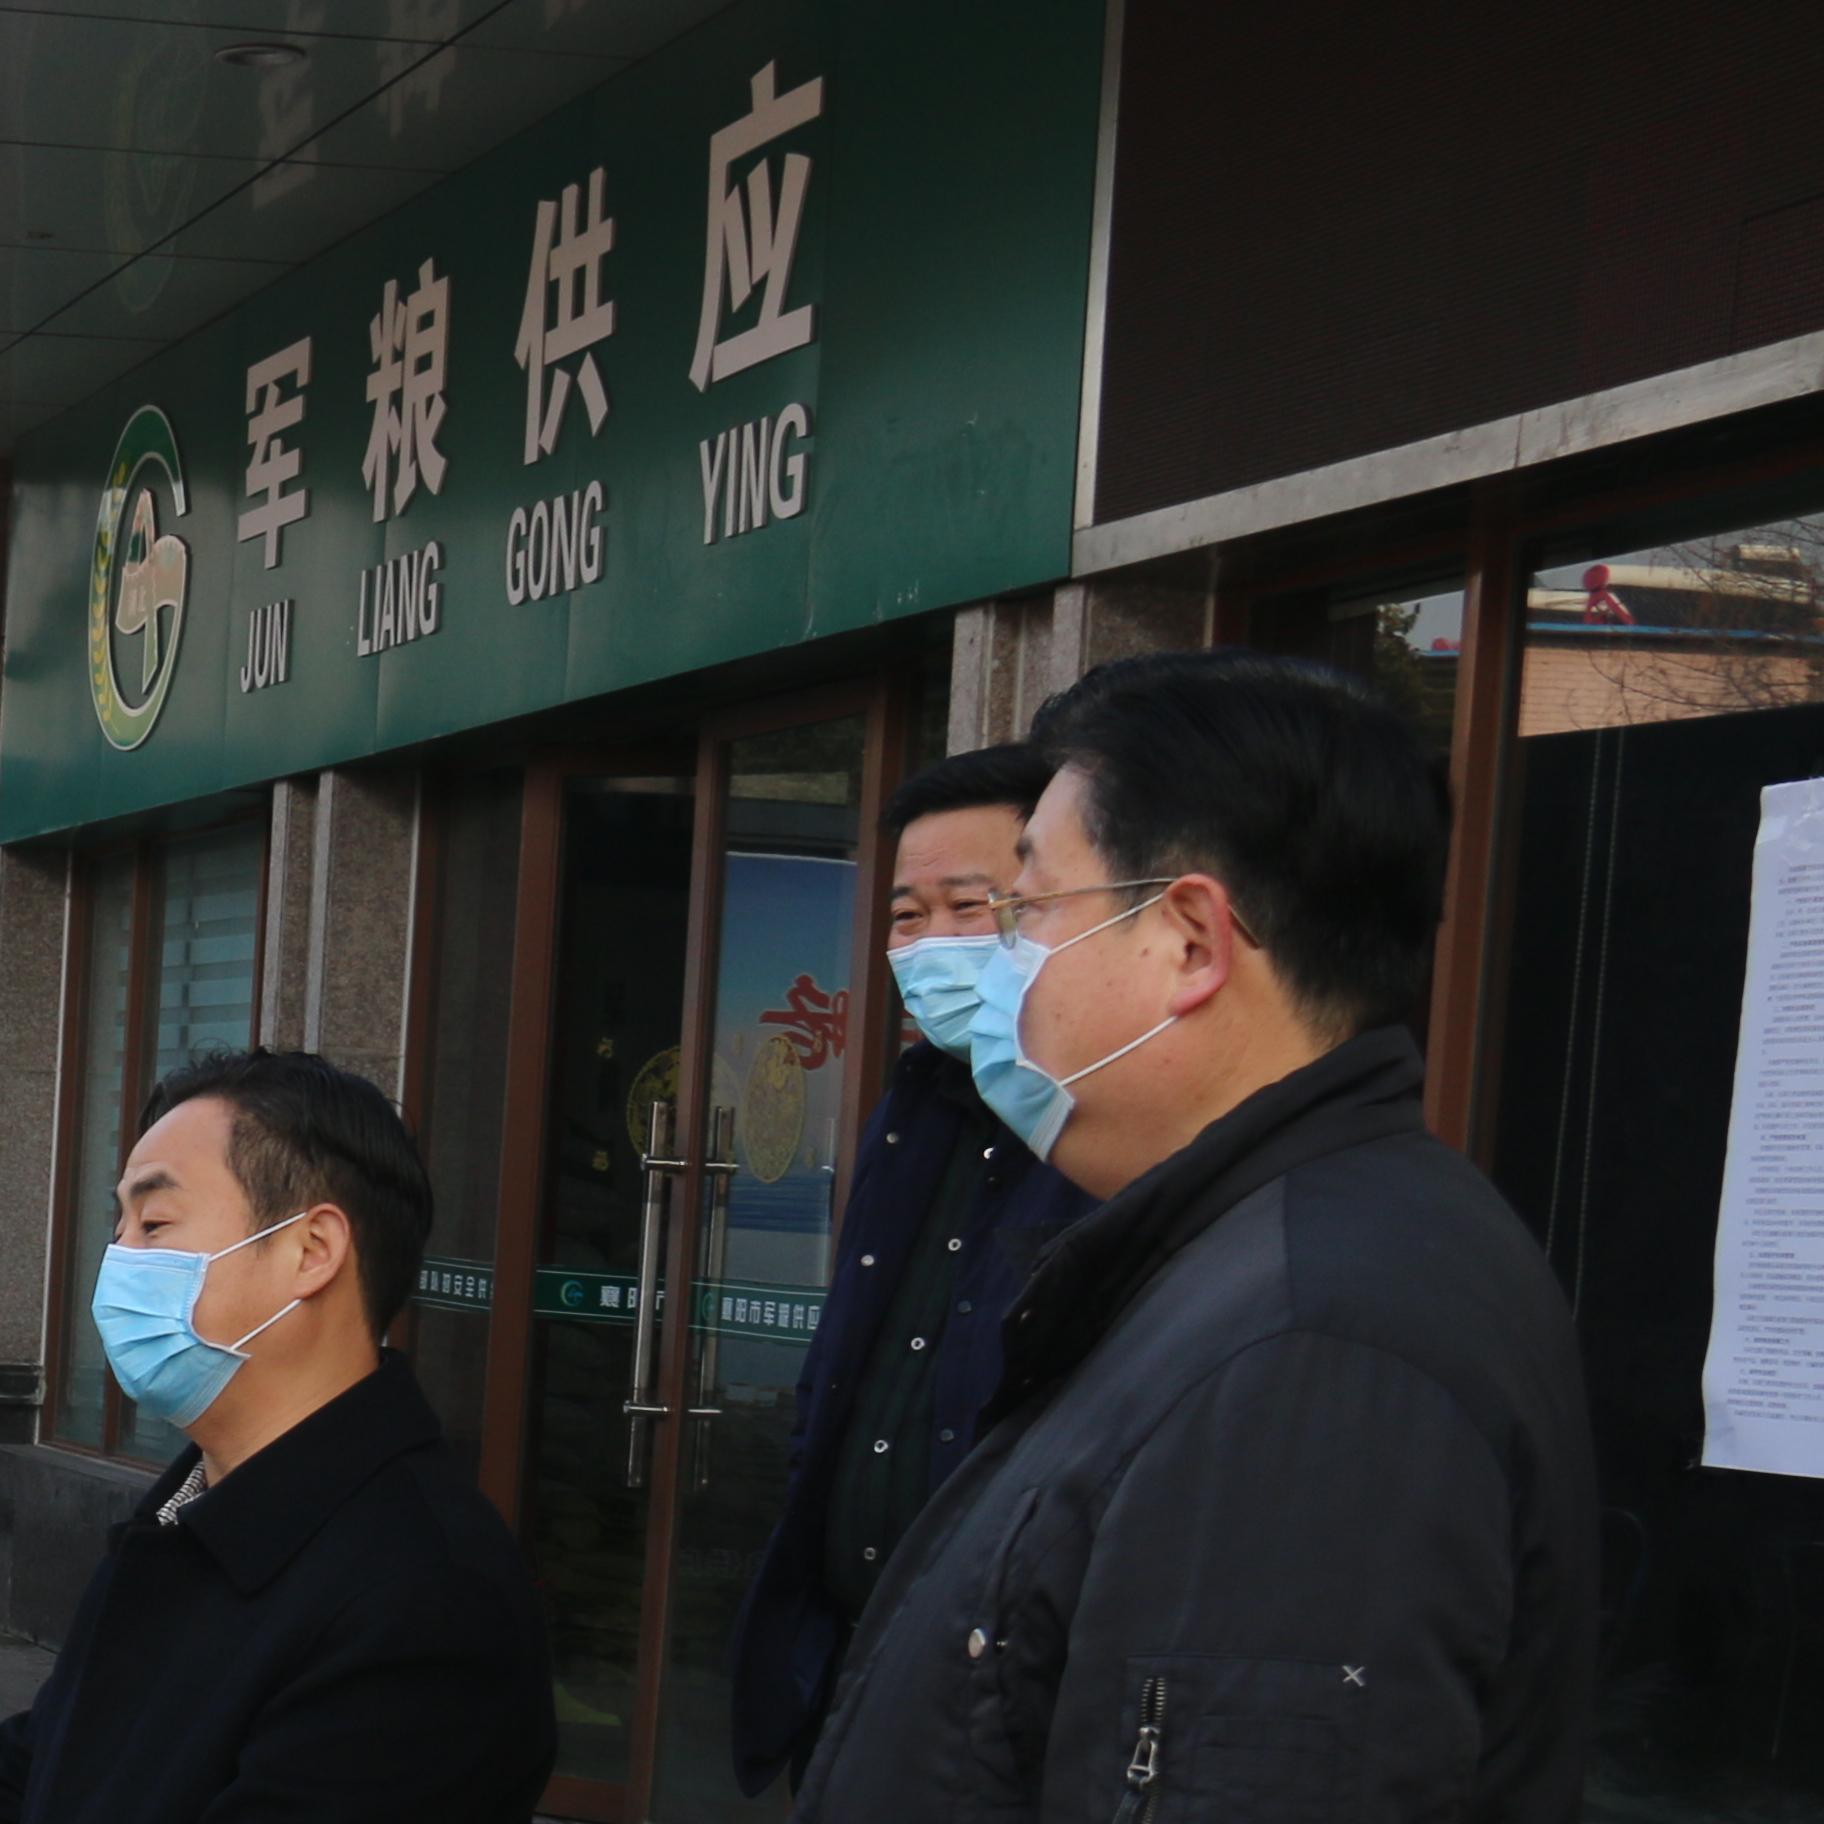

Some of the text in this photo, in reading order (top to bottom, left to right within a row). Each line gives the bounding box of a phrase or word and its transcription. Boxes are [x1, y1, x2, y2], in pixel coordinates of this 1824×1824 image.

[237, 59, 825, 571] 军粮供应
[240, 402, 813, 693] JUN LIANG GONG YING
